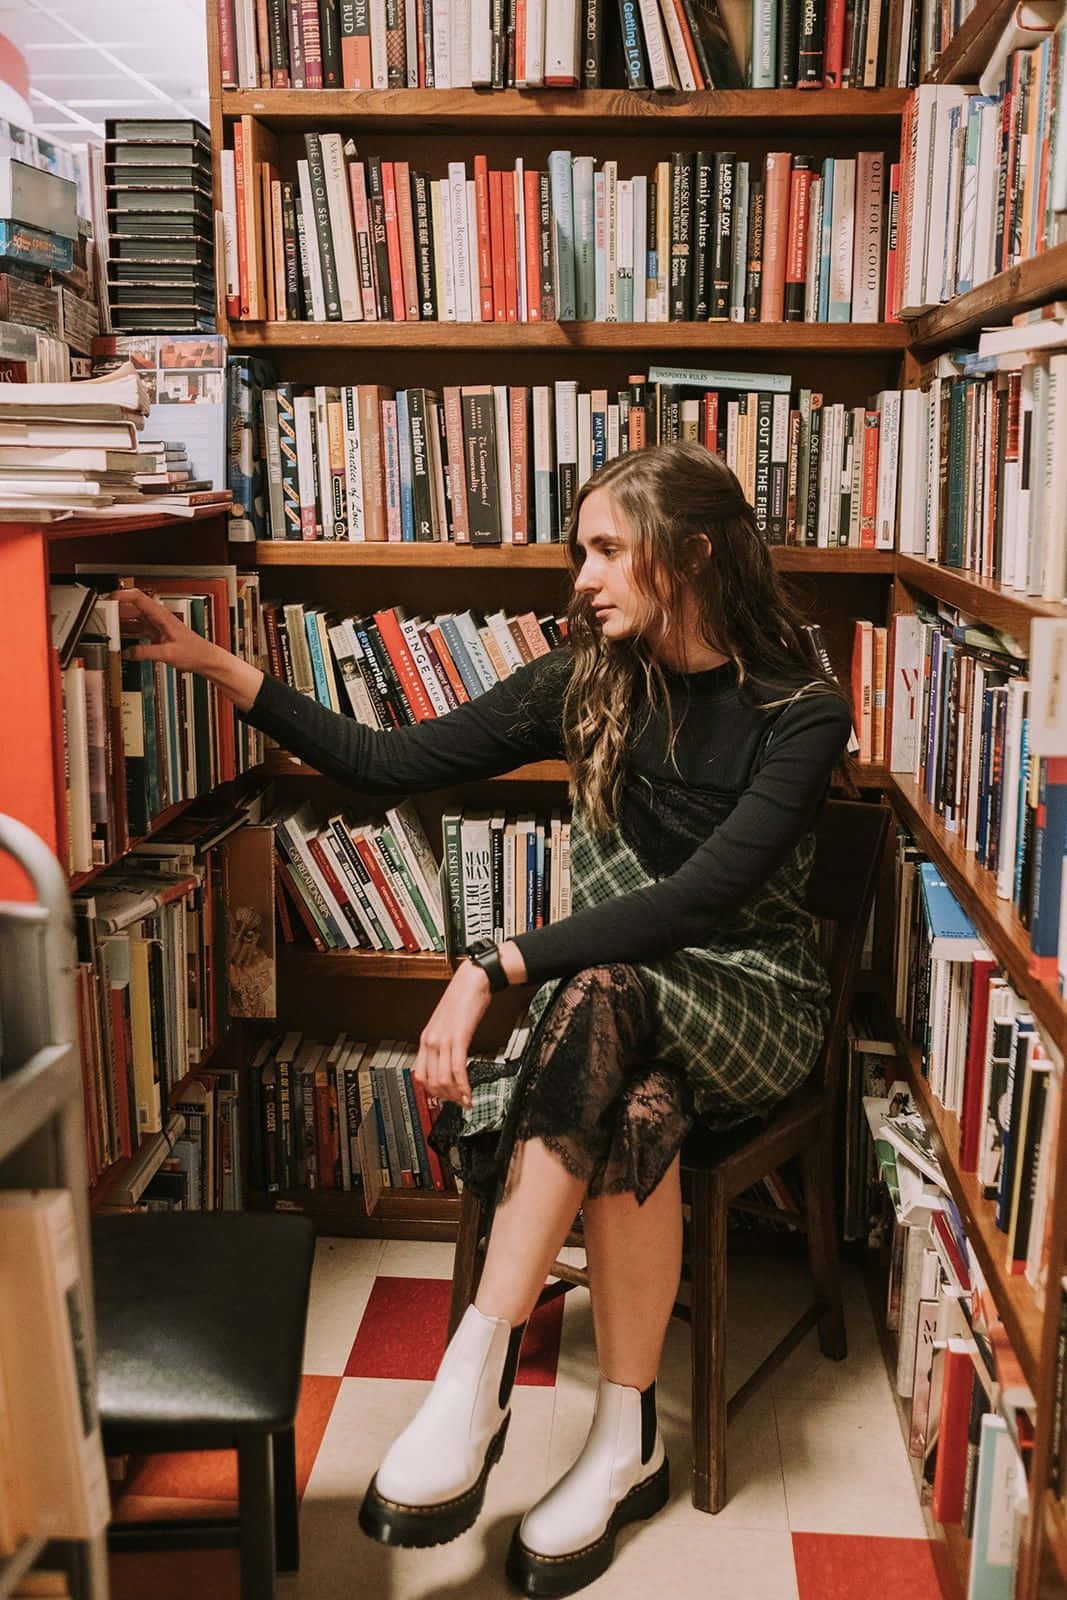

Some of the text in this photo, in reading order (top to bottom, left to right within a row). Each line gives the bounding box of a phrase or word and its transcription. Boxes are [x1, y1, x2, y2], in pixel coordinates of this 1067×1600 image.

[343, 4, 354, 34] BUD
[303, 18, 321, 63] HEALING
[623, 3, 641, 79] Getting It On
[308, 138, 320, 159] THE
[312, 161, 324, 184] JOY
[315, 186, 325, 201] OF
[415, 178, 426, 202] STRAIGHT
[541, 175, 551, 225] JEFFREY WEEKS
[679, 166, 691, 241] SAME-SEX UNIONS
[721, 163, 733, 237] LABOR OF LOVE
[317, 207, 327, 227] SEX
[417, 202, 427, 217] FROM
[418, 217, 427, 228] THE
[697, 165, 712, 248] family values
[754, 194, 764, 228] SAME-SEX
[375, 225, 386, 244] SEX
[418, 228, 428, 244] HEART
[453, 183, 468, 287] Queering Reproduction
[671, 218, 682, 241] EUROPE
[796, 174, 807, 279] LISTENING TO THE SIRENS
[866, 160, 883, 291] OUT FOR GOOD
[753, 229, 763, 257] UNIONS
[671, 257, 680, 287] BOSWELL
[679, 257, 687, 277] JOHN
[671, 403, 679, 425] BOYS
[882, 401, 893, 443] and Others
[411, 416, 426, 476] inside/out
[480, 436, 488, 449] The
[595, 417, 606, 458] MEN LIKE
[810, 434, 819, 455] LOVE
[888, 397, 900, 470] Accepting Ourselves
[348, 439, 359, 482] Practice
[468, 436, 479, 493] Homosexuality
[480, 449, 489, 499] Construction
[756, 416, 770, 532] OUT IN THE FIELD
[789, 444, 800, 497] STAGESTRUCK
[809, 467, 817, 482] THE
[349, 487, 361, 498] of
[808, 483, 816, 501] TIME
[850, 459, 861, 523] IN THE LIFE
[350, 502, 362, 529] Love
[807, 514, 815, 528] HIV
[808, 502, 815, 513] OF
[357, 630, 390, 695] gaymarriage
[433, 662, 448, 686] Violent
[399, 649, 430, 717] QUEER SPIRITS
[426, 676, 442, 702] TYLER
[465, 851, 490, 865] MAD
[465, 865, 490, 880] MAN
[493, 833, 502, 894] vanishing rooms
[288, 846, 303, 863] GAY
[296, 863, 331, 920] RELATIONSHIPS
[465, 884, 481, 937] DELANY
[479, 883, 492, 923] SAMUEL
[279, 1062, 290, 1121] OUT OF THE BLUE
[266, 1101, 276, 1133] CLOSET
